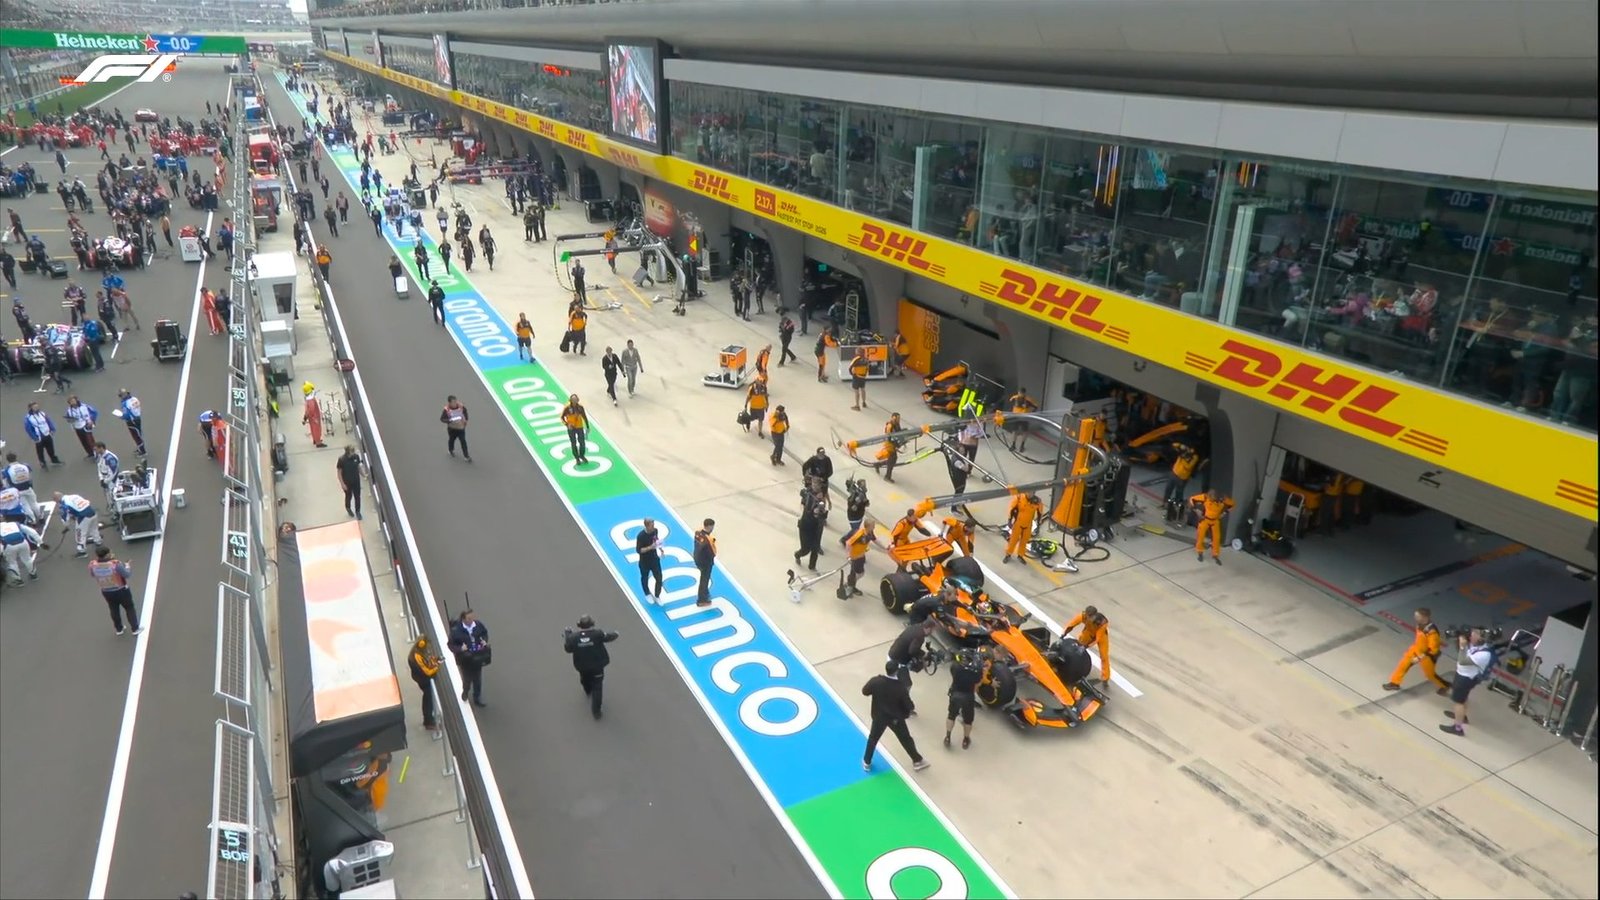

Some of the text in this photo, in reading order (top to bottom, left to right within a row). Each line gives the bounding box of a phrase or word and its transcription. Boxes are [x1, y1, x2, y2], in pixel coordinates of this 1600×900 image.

[54, 32, 140, 50] Heineken
[567, 129, 586, 148] DHL
[694, 170, 731, 200] DHL
[860, 222, 930, 270] DHL
[997, 269, 1106, 332] DHL
[445, 299, 516, 357] aramco
[1213, 339, 1406, 438] DHL
[229, 535, 247, 548] 41
[223, 830, 241, 847] 5
